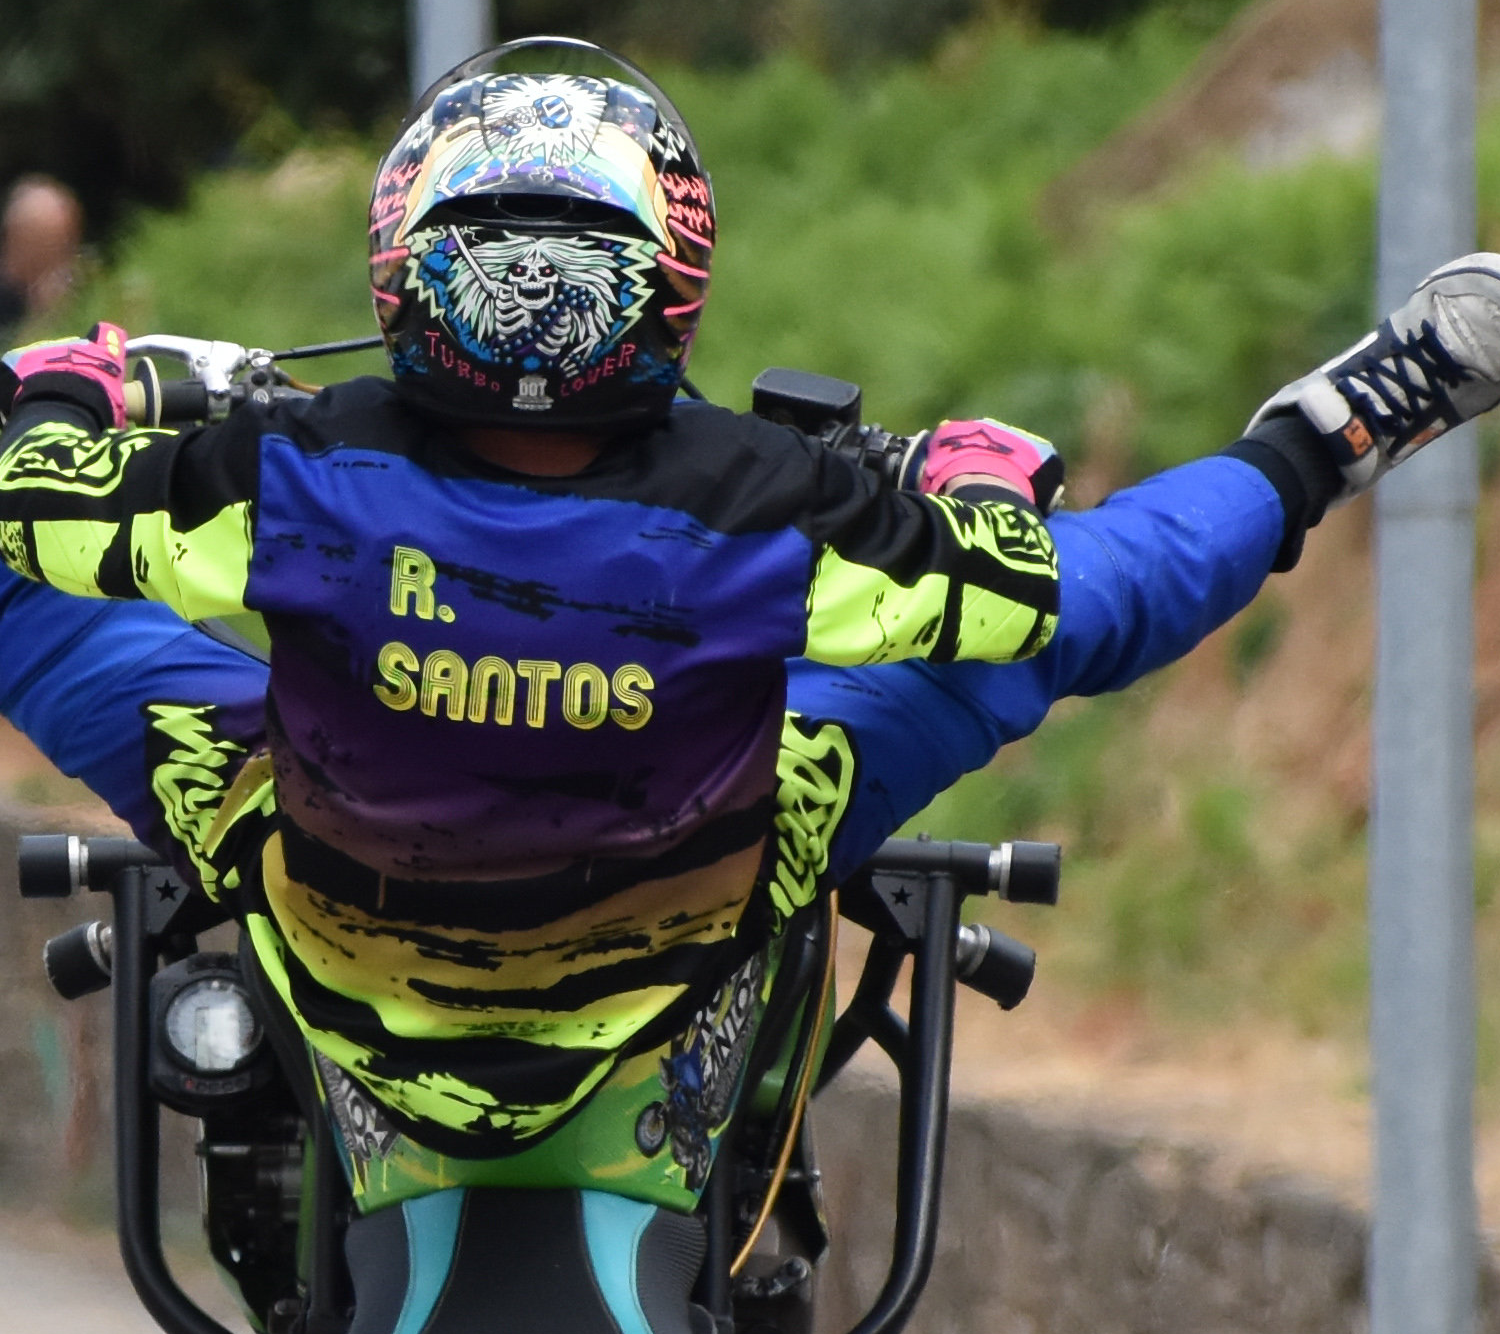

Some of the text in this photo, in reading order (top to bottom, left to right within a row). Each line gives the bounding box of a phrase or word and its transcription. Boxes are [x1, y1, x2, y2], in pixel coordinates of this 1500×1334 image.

[425, 331, 636, 397] TURBO LOVER
[519, 378, 547, 396] DOT
[390, 545, 456, 623] R.
[373, 641, 655, 731] SANTOS
